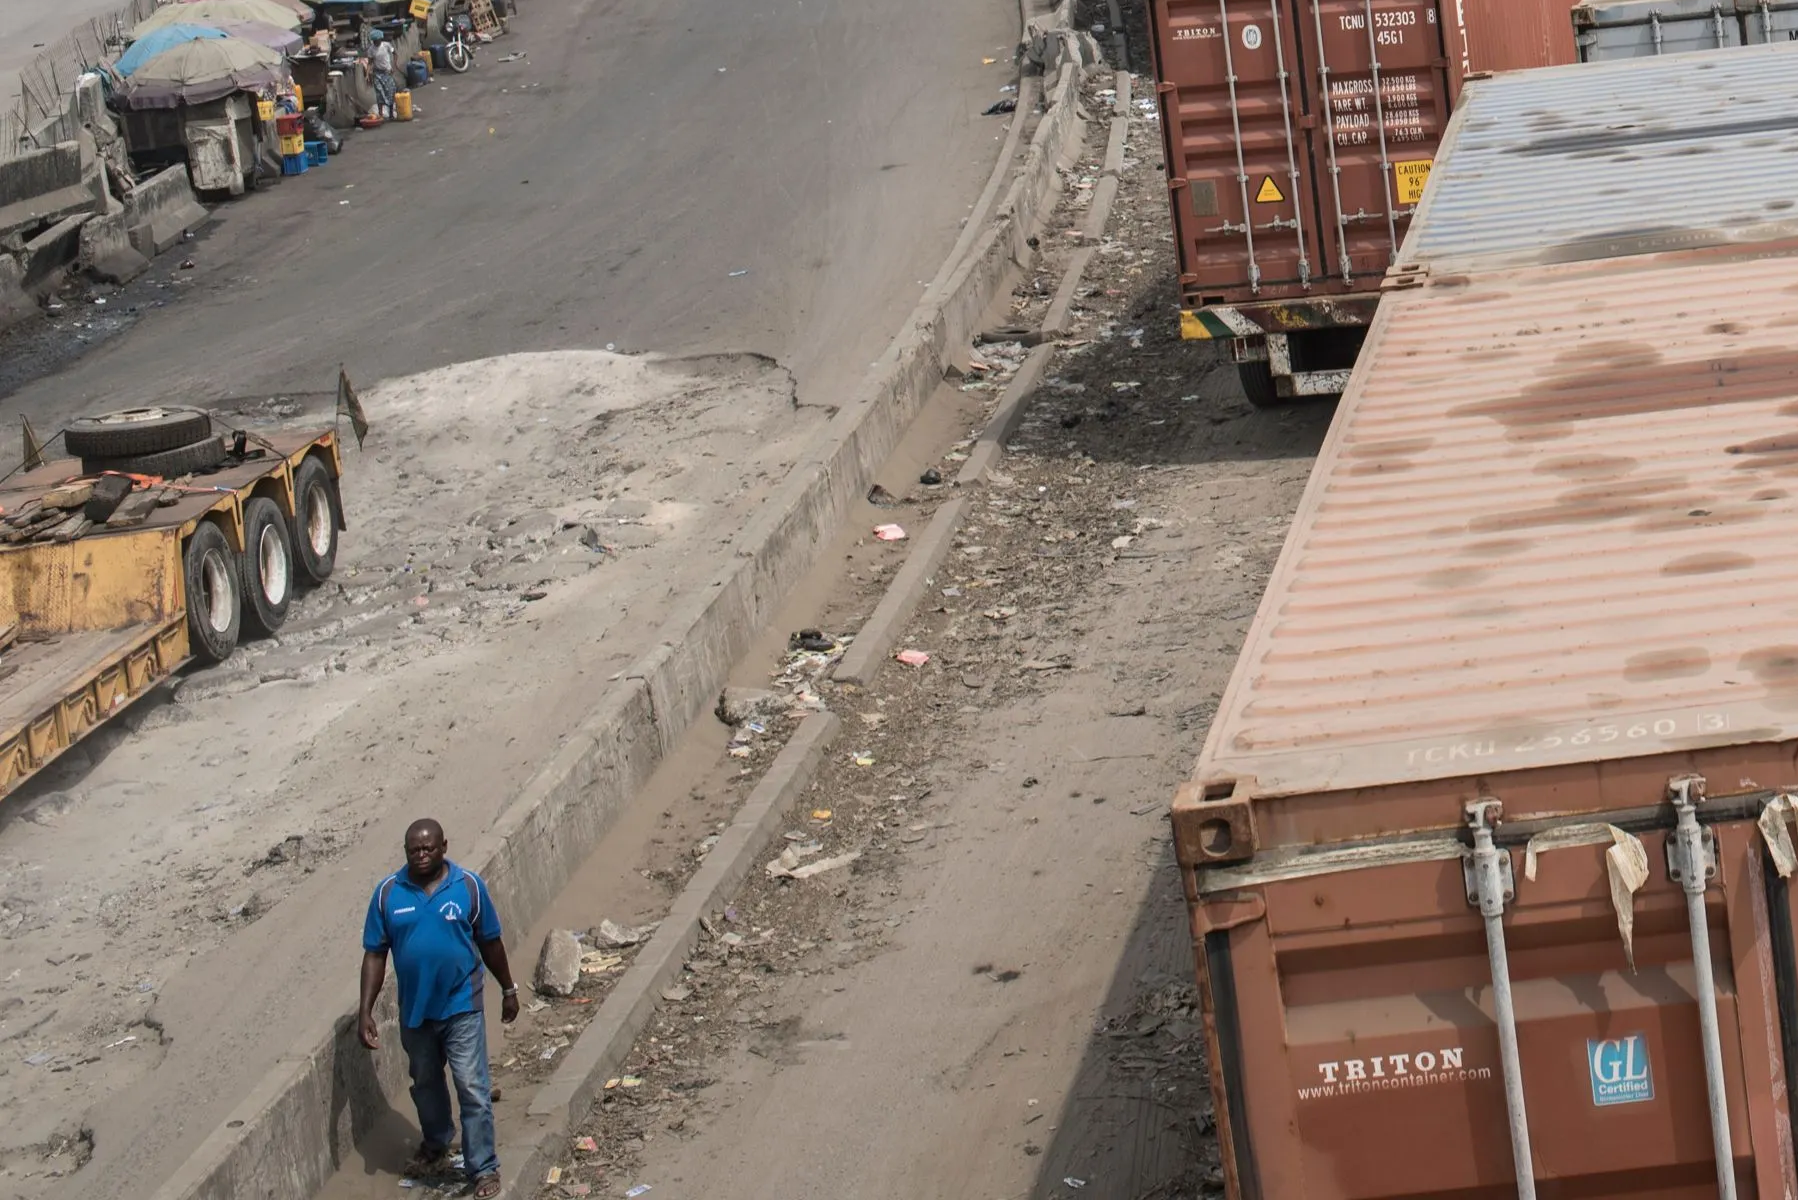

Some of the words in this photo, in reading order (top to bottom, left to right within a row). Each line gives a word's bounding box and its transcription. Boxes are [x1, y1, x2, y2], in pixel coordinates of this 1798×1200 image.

[1339, 15, 1365, 30] TCNU
[1375, 11, 1416, 27] 532303
[1177, 27, 1216, 37] TRITON
[1377, 30, 1403, 45] 45G1
[1332, 79, 1373, 95] MAXGROSS
[1405, 75, 1416, 84] KGS
[1405, 83, 1417, 91] LBS
[1333, 99, 1351, 112] TARE
[1355, 97, 1369, 110] WT.
[1336, 113, 1370, 129] PAYLOAD
[1408, 109, 1420, 117] KGS
[1337, 132, 1351, 146] CU.
[1352, 131, 1371, 145] CAP.
[1398, 163, 1431, 175] CAUTION
[1406, 743, 1495, 765] TCKU
[1515, 718, 1677, 753] 256560
[1703, 712, 1724, 731] 3
[1319, 1047, 1463, 1083] TRITON
[1593, 1035, 1648, 1084] GL
[1298, 1065, 1491, 1100] www.tritoncontainer.com
[1599, 1080, 1648, 1096] Certified
